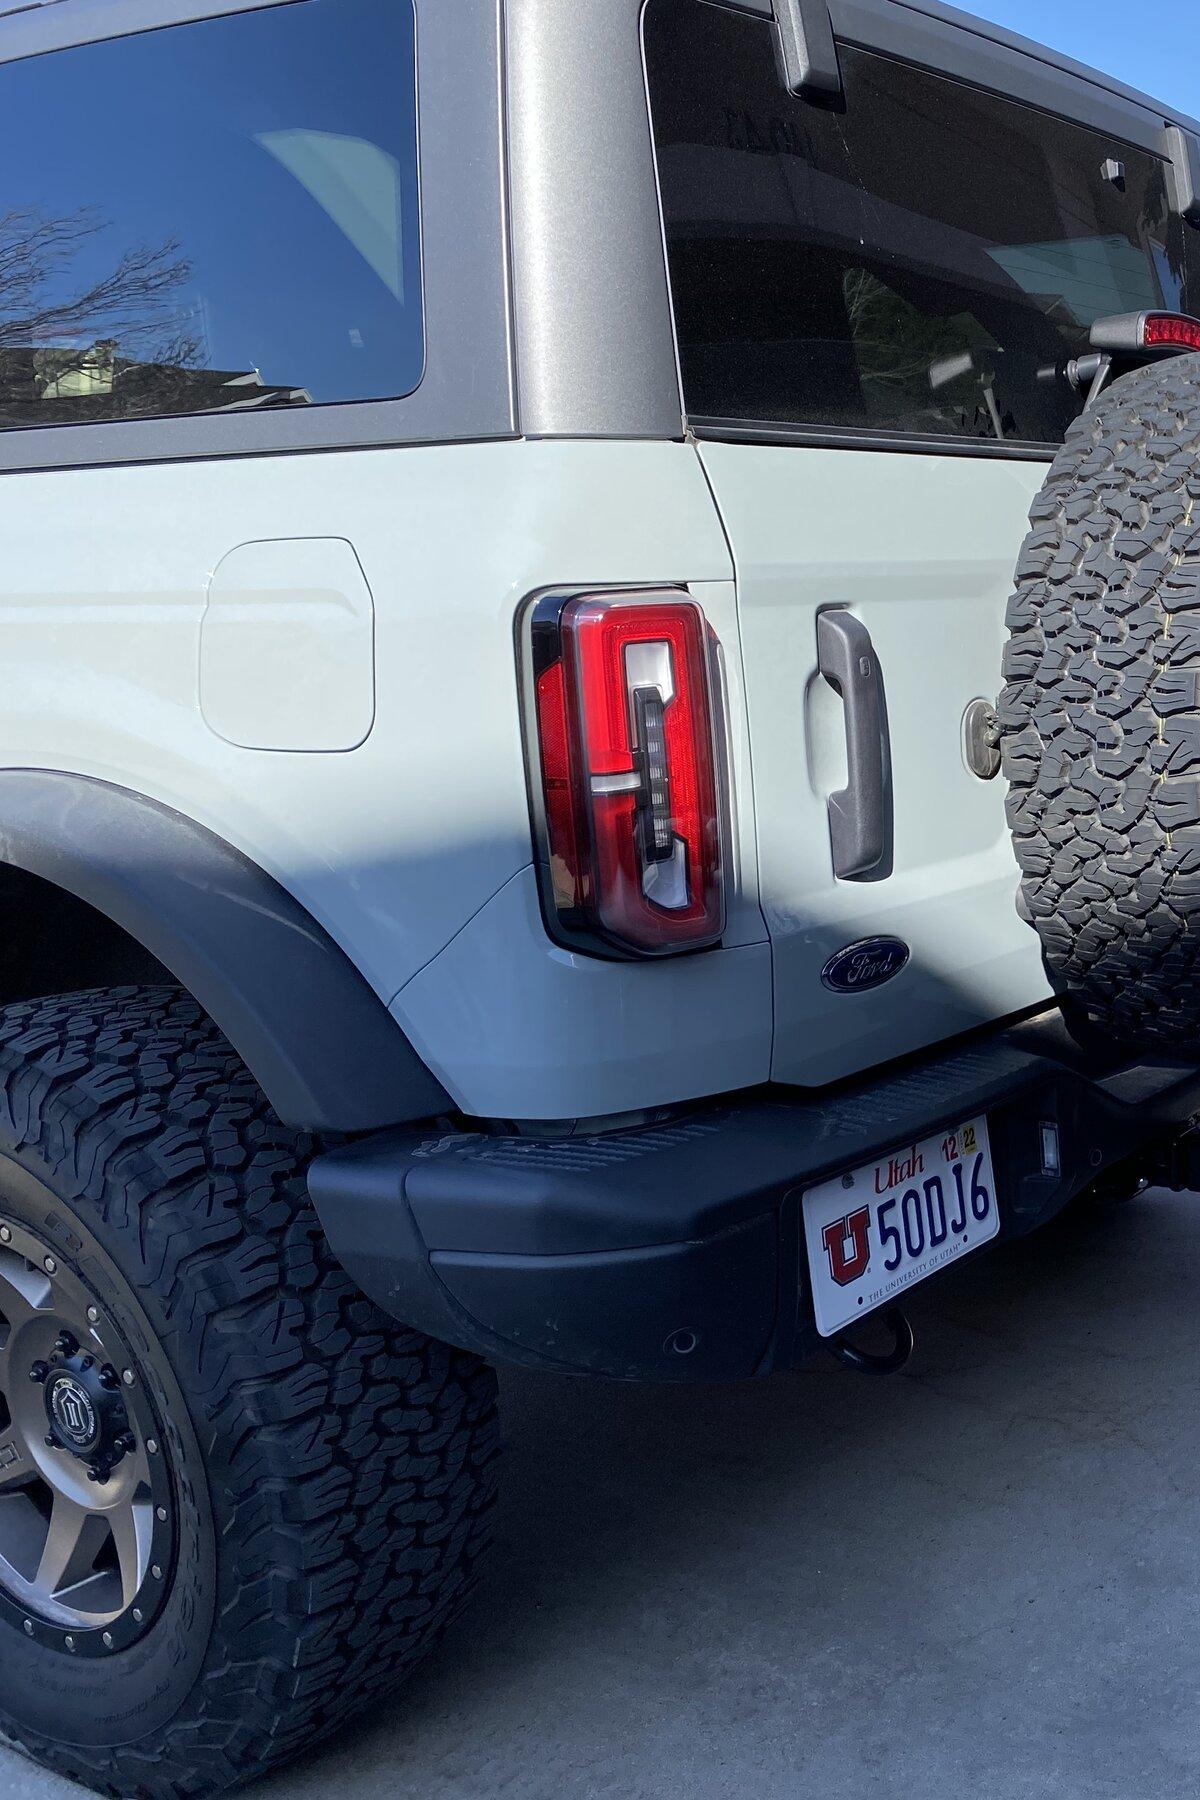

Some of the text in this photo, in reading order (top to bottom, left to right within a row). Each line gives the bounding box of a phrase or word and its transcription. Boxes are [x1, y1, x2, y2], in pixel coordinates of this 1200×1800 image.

[847, 949, 893, 983] Ford
[941, 1135, 959, 1162] 12
[963, 1127, 976, 1149] 22
[874, 1144, 926, 1195] Utah
[821, 1151, 990, 1288] U 50DJ6
[868, 1244, 959, 1303] THE UNIVERSITY OF UTAH
